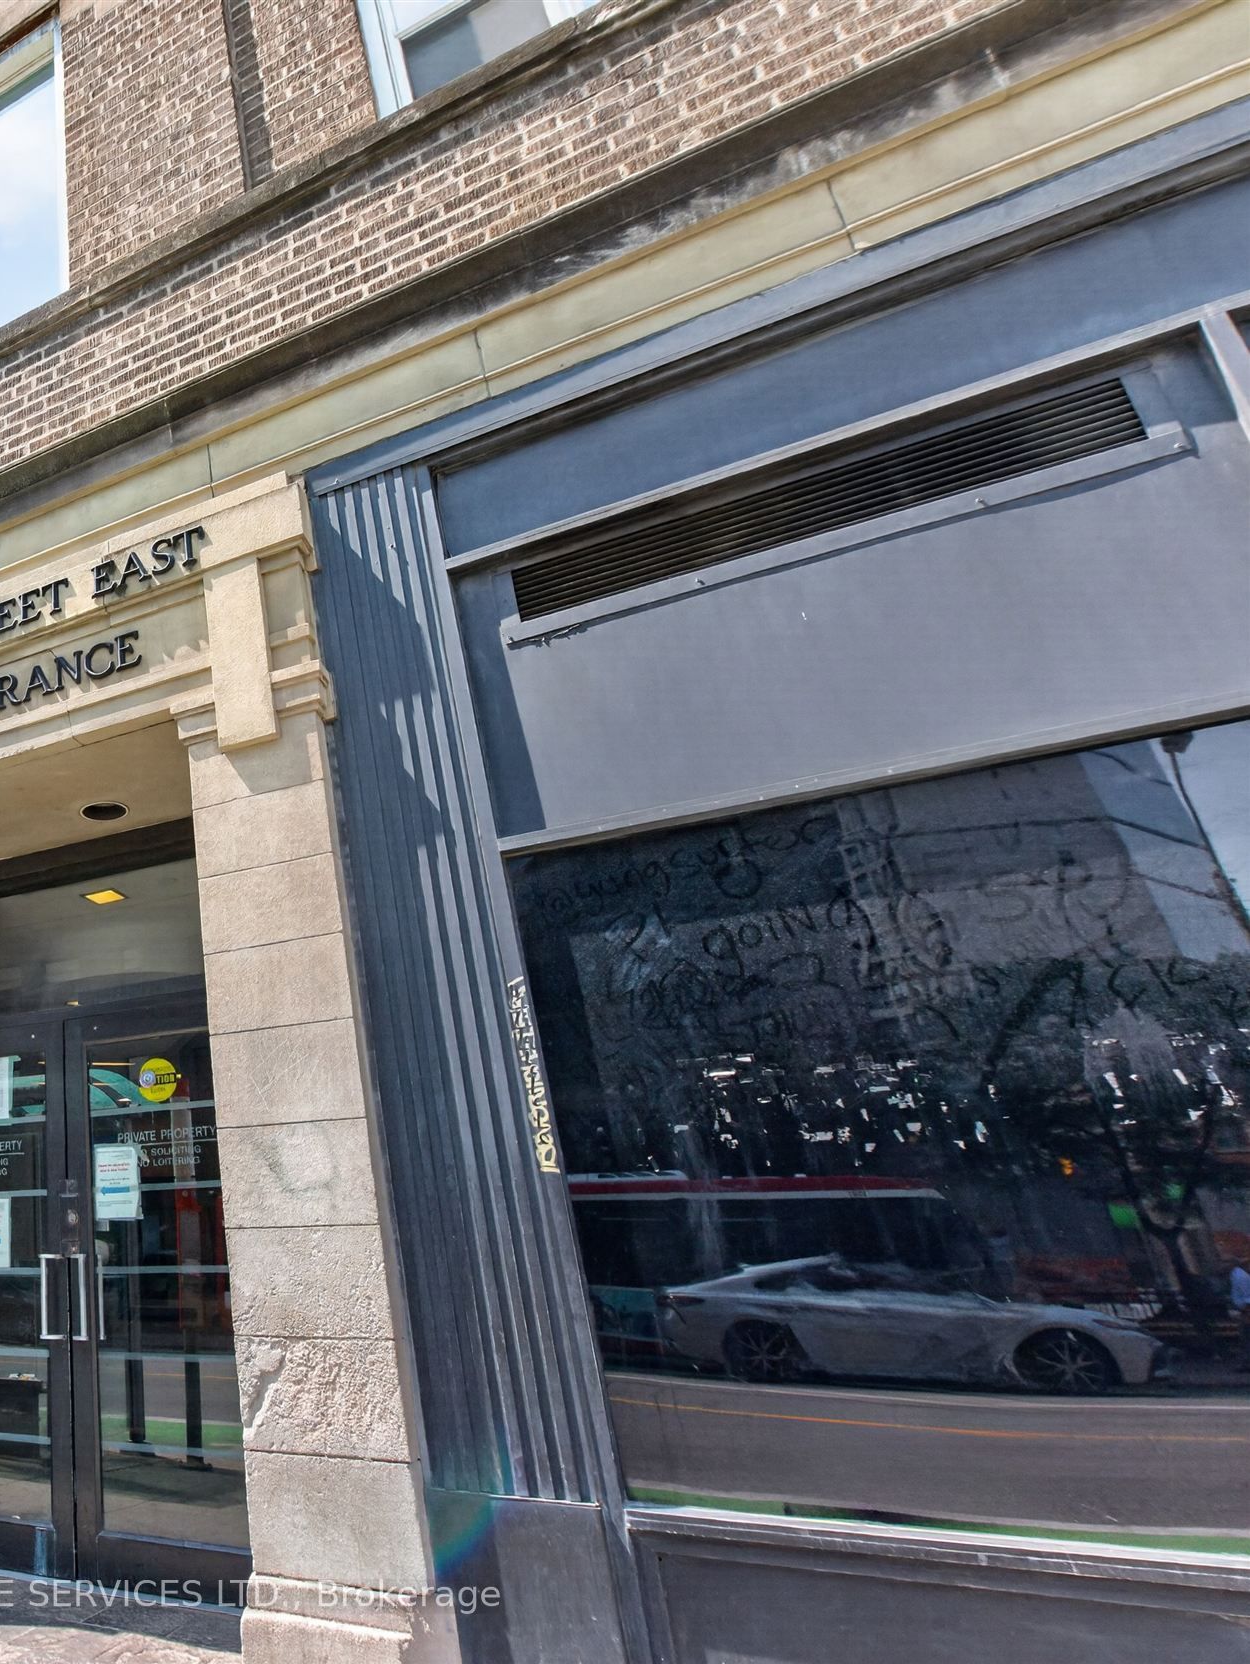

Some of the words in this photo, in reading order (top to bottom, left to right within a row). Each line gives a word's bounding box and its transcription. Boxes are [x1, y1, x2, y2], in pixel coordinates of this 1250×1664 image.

[90, 525, 205, 599] EAST
[117, 1130, 157, 1143] PRIVATE
[160, 1125, 217, 1140] PROPERTY
[150, 1144, 202, 1157] SOLICITING
[152, 1156, 201, 1167] LOITERING
